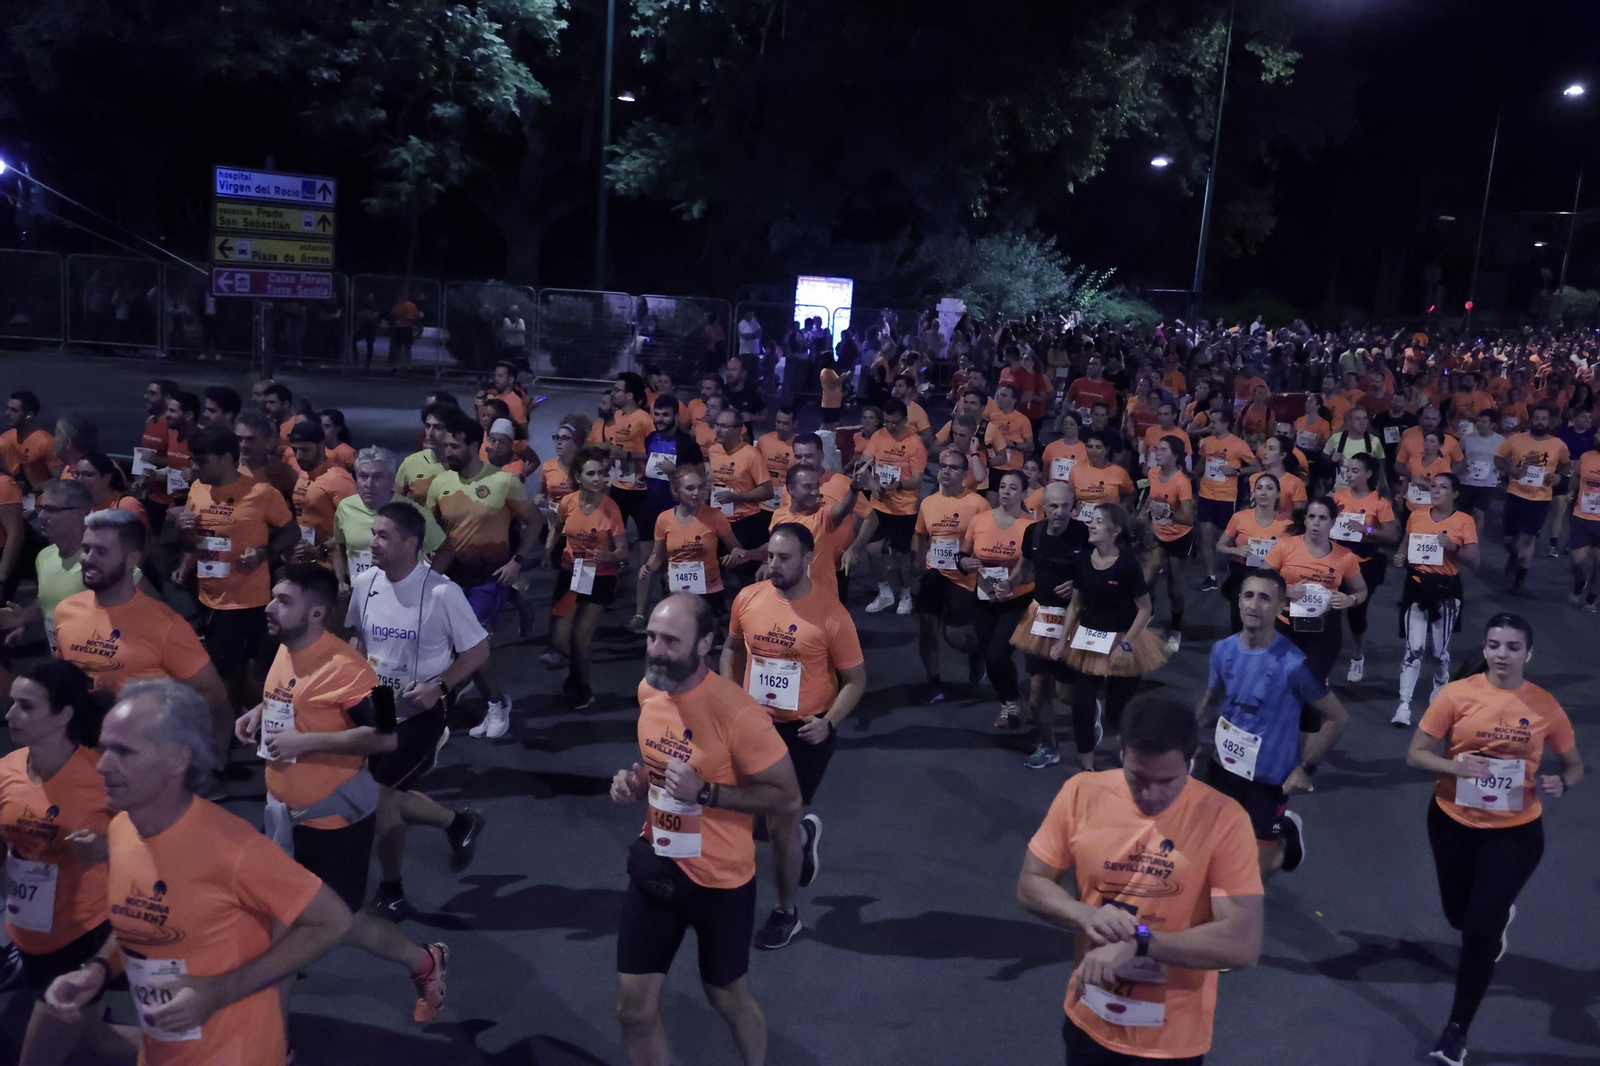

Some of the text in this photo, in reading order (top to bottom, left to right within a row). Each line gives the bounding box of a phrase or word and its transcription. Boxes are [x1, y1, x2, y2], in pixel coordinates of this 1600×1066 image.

[218, 171, 252, 182] hospital
[218, 180, 251, 193] Virgen
[255, 184, 271, 195] del
[256, 207, 284, 218] Prado
[218, 216, 238, 227] San
[251, 250, 331, 265] Plaza de Armas
[268, 273, 330, 285] Caixa Forum
[266, 284, 329, 296] Torre Sevilla
[1081, 510, 1094, 518] 162
[933, 548, 953, 558] 11356
[1416, 543, 1438, 553] 21560
[675, 572, 698, 582] 14876
[1302, 594, 1323, 604] 3658
[1046, 614, 1063, 625] 1392
[372, 623, 417, 641] Ingesan
[766, 630, 796, 642] NOCTURNA
[85, 639, 119, 651] NOCTURNA
[752, 634, 779, 645] SEVILLA
[69, 642, 98, 656] SEVILLA
[758, 673, 789, 689] 11629
[1475, 731, 1511, 741] SEVILLA
[1493, 726, 1532, 738] NOCTURNA
[644, 738, 673, 757] SEVILLA
[659, 736, 693, 755] NOCTURNA
[1222, 738, 1246, 758] 4825
[1474, 777, 1513, 790] 19972
[654, 810, 682, 831] 1450
[1102, 860, 1145, 874] SEVILLA
[1126, 854, 1175, 869] NOCTURNA
[125, 896, 170, 914] NOCTURNA
[110, 903, 143, 920] SEVILLA
